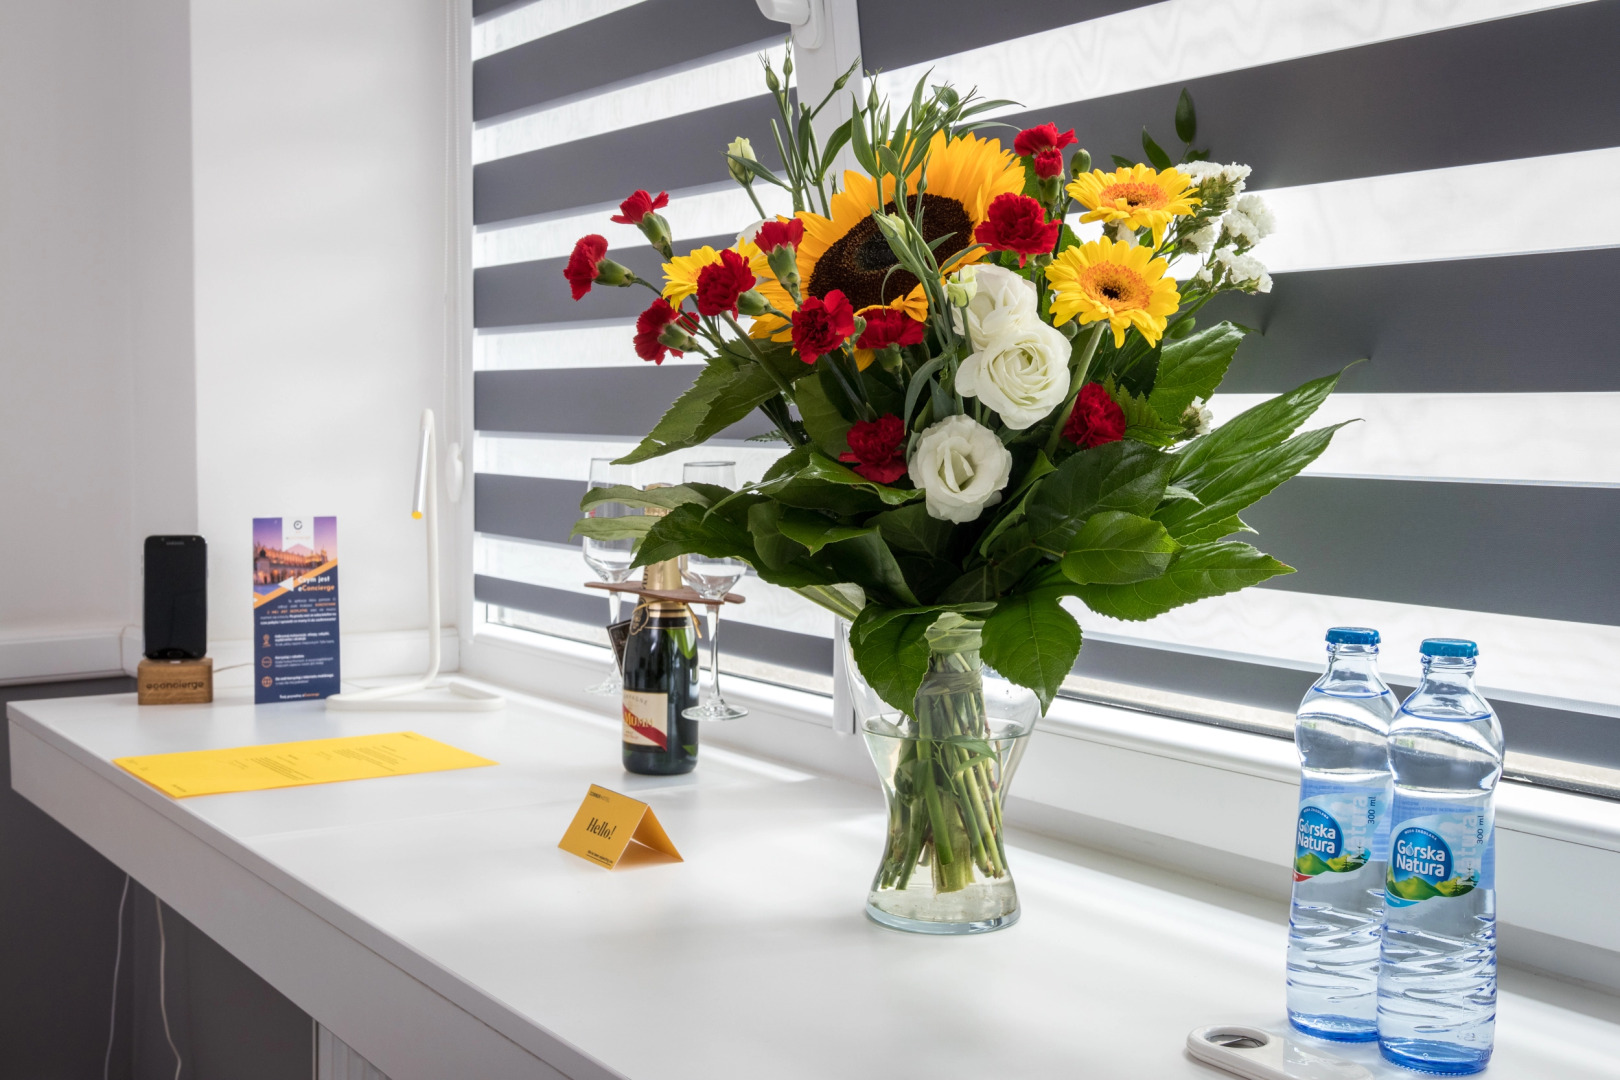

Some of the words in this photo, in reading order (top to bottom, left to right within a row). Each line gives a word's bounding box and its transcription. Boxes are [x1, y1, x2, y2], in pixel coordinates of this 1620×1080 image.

[1368, 796, 1376, 807] ml
[1368, 809, 1376, 824] 300
[1477, 815, 1484, 826] ml
[586, 817, 617, 840] Hello!
[1297, 831, 1336, 854] Natura
[1397, 839, 1446, 862] Górska
[1396, 853, 1445, 877] Natura
